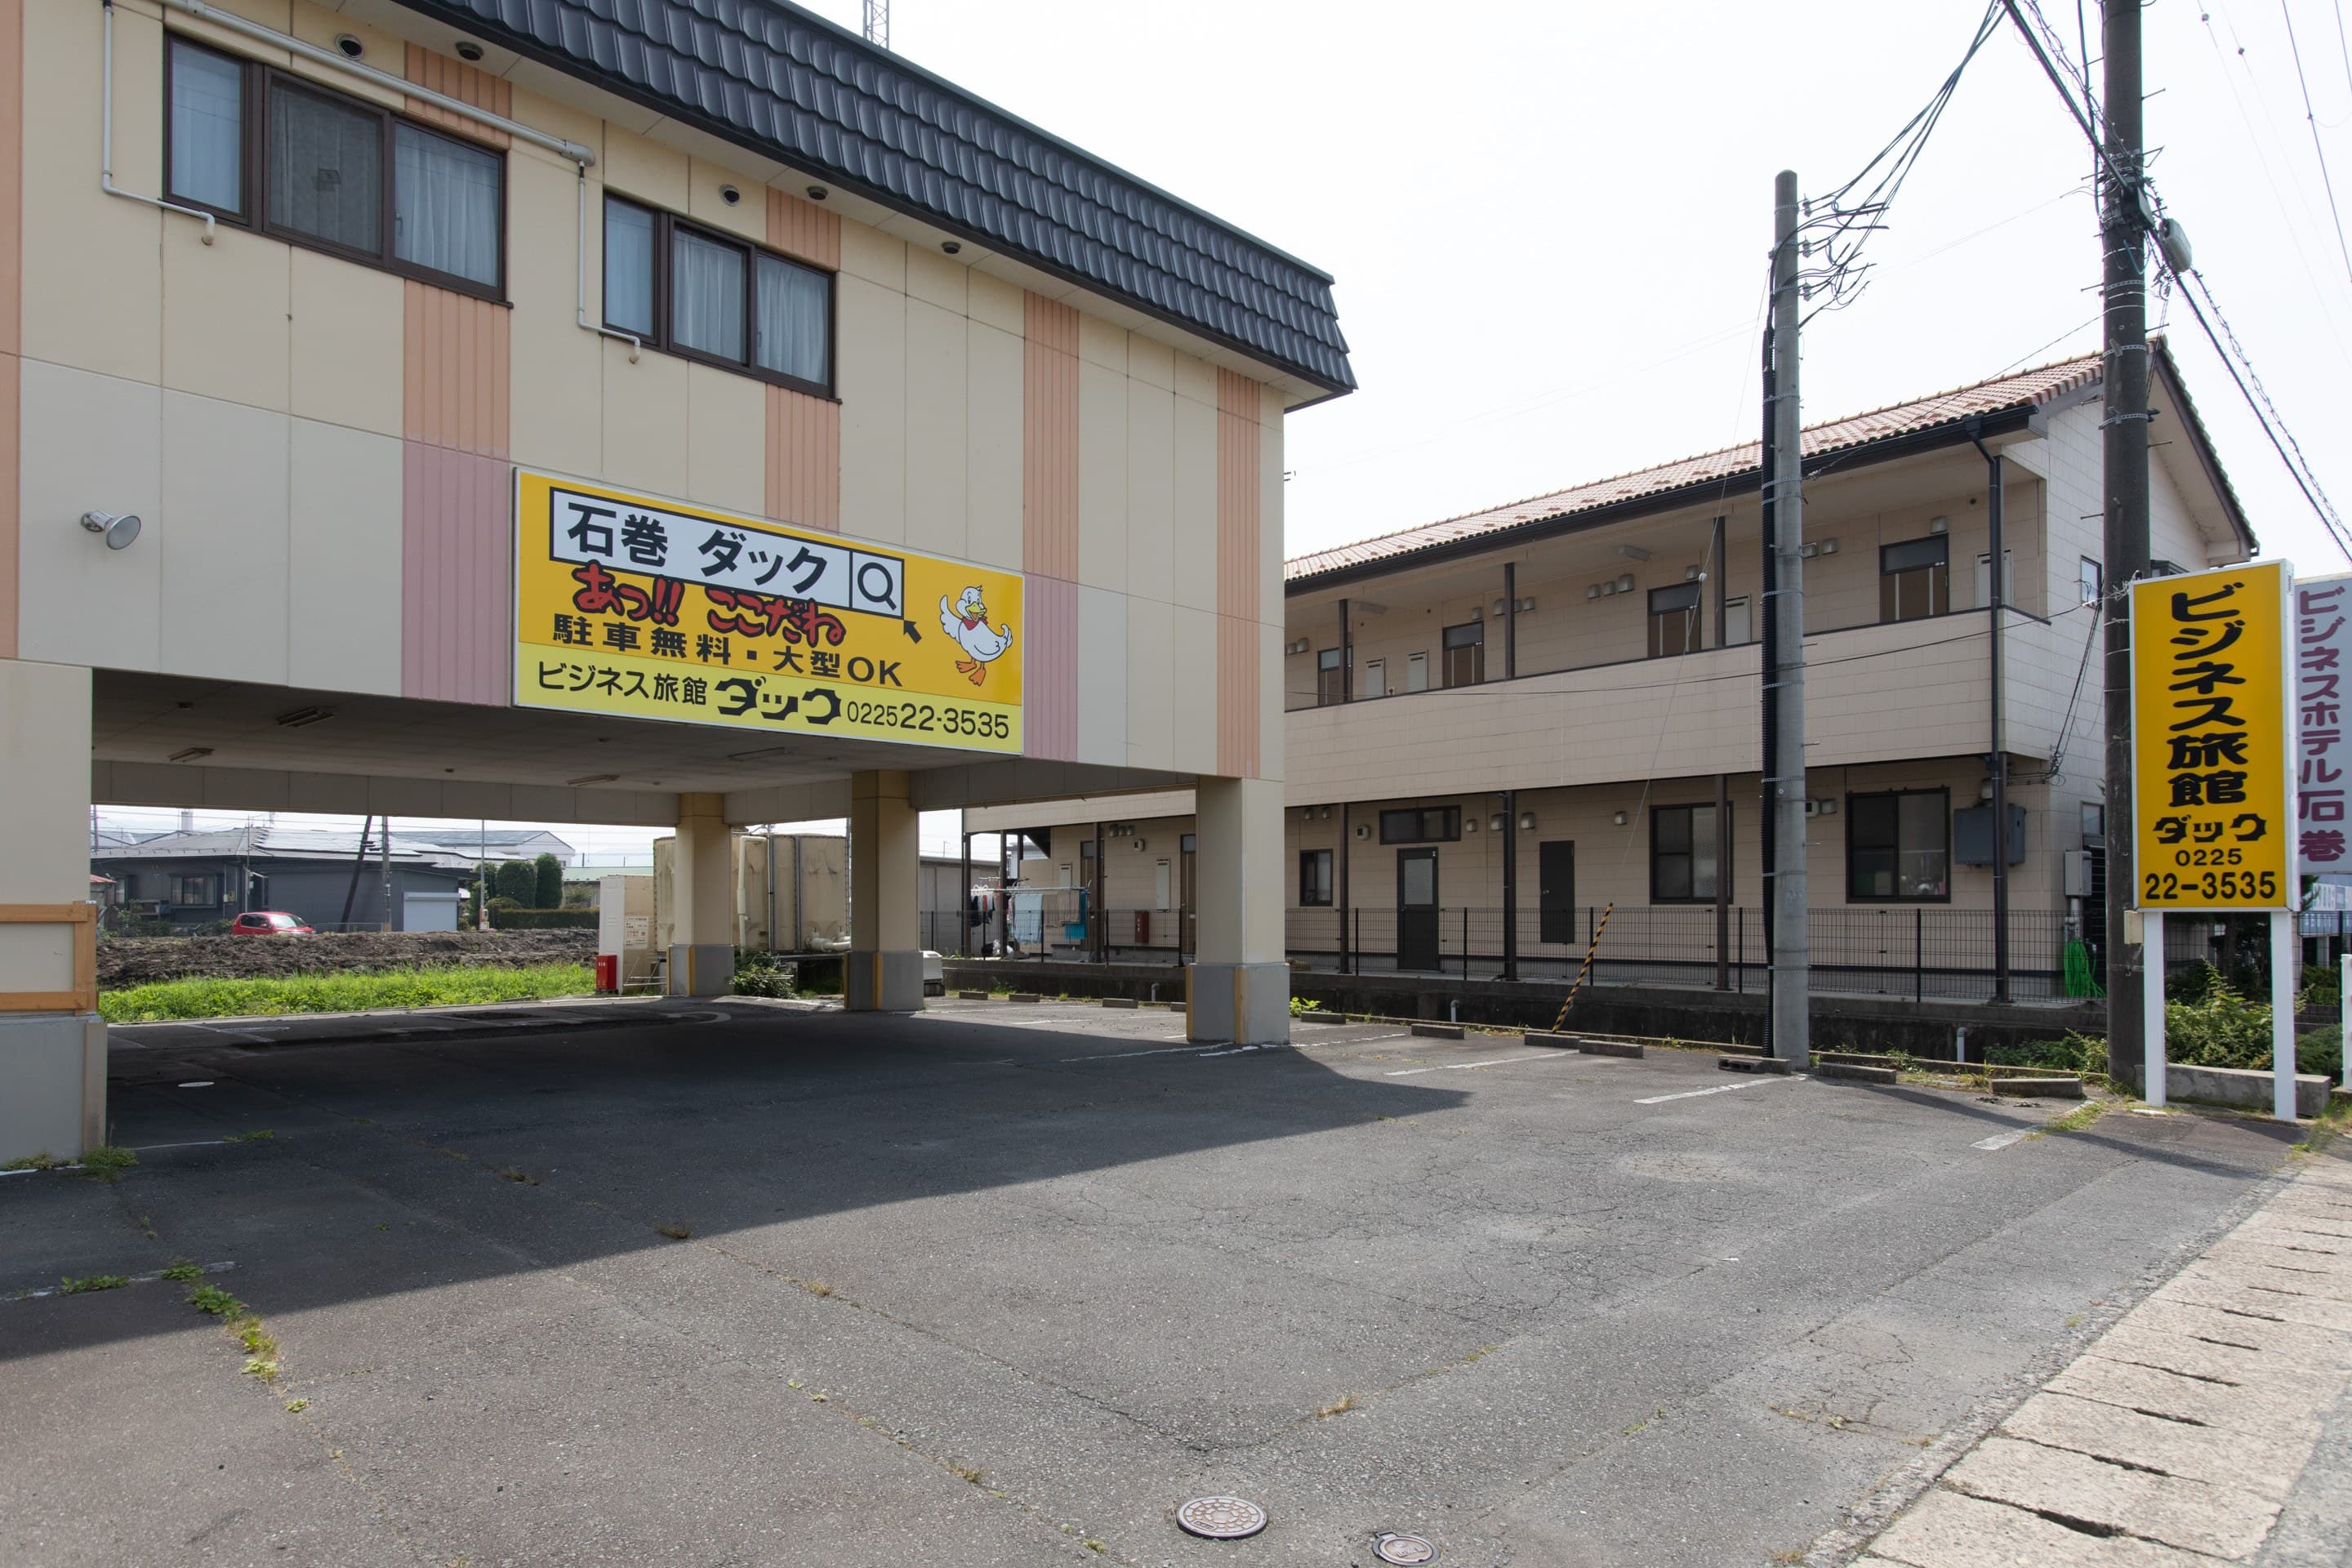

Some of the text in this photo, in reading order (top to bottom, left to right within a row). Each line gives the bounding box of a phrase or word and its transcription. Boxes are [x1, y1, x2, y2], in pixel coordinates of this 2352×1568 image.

[567, 502, 827, 594] 石巻 ダック
[705, 585, 846, 647] ここだね
[538, 661, 708, 707] ビジネス旅館
[2167, 581, 2249, 808] ビジネス旅館
[2299, 586, 2346, 862] ビジネスホテル石巻
[2153, 813, 2267, 844] ダック
[2175, 848, 2243, 866] 0225
[2145, 871, 2276, 900] 22-3535
